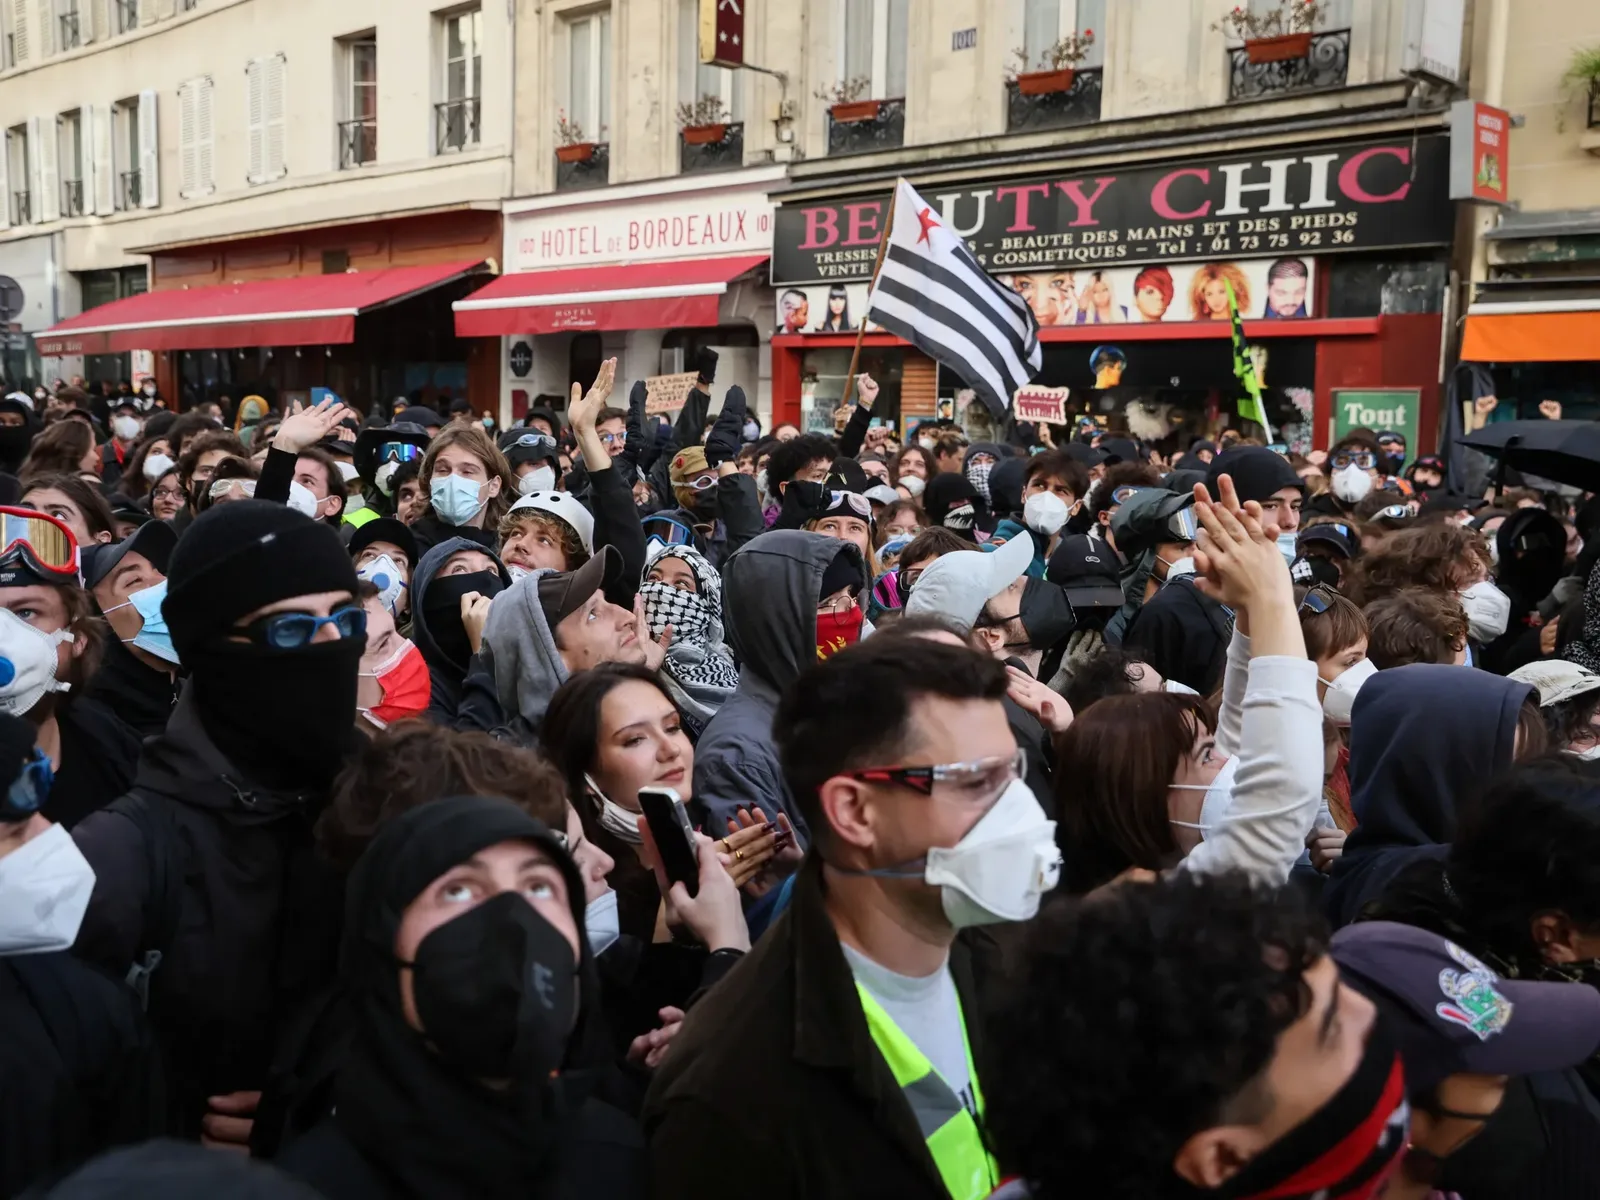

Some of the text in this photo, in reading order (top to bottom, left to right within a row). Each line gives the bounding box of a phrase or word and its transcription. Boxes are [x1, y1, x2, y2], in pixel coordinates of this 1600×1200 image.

[798, 147, 1412, 250] BEUTY CHIC
[541, 226, 602, 258] HOTEL
[607, 237, 622, 252] DE
[629, 209, 747, 251] BORDEAUX
[993, 245, 1127, 265] COSMETIQUES
[1211, 238, 1230, 251] 01
[1240, 237, 1259, 250] 73
[1268, 234, 1289, 247] 75
[1299, 232, 1321, 245] 92
[1332, 230, 1354, 244] 36
[1002, 233, 1073, 250] BEAUTE
[1082, 230, 1119, 244] DES
[1127, 224, 1194, 241] MAINS
[1203, 221, 1230, 236] ET
[1238, 217, 1280, 234] DES
[1290, 212, 1358, 230] PIEDS
[814, 249, 878, 264] TRESSES
[818, 262, 869, 277] VENTE
[1343, 402, 1406, 426] Tout
